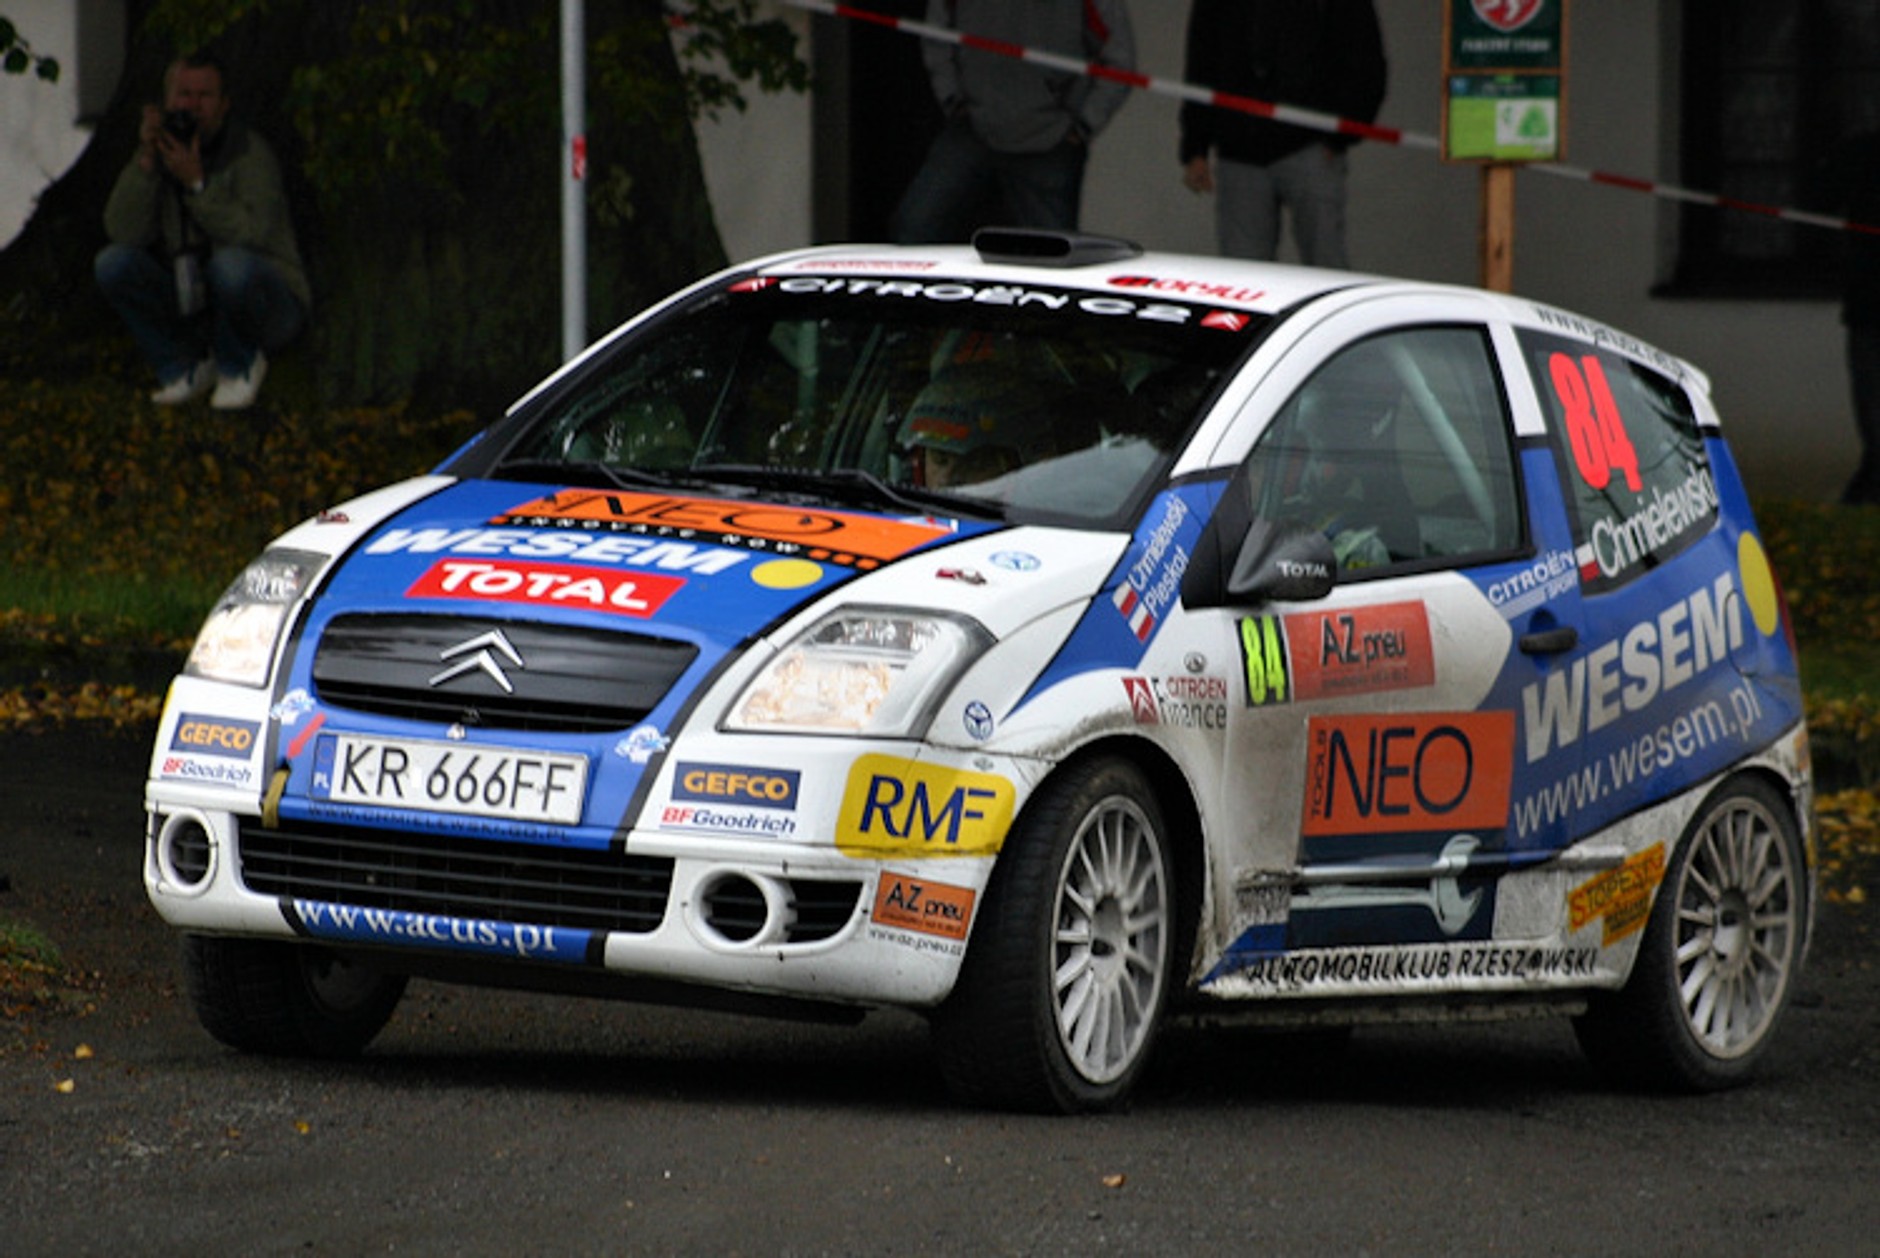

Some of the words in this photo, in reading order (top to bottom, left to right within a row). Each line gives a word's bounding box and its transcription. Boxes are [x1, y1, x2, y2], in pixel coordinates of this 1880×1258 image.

[1078, 297, 1192, 324] C2
[1549, 352, 1643, 492] 84
[365, 528, 750, 576] WESEM
[1488, 549, 1576, 607] CITROËN
[441, 563, 649, 610] TOTAL
[1241, 614, 1286, 705] 84
[1321, 614, 1361, 667] AZ
[1522, 571, 1744, 765] WESEM
[179, 722, 252, 750] GEFCO
[1514, 677, 1763, 839] www.wesem.pl
[313, 773, 329, 788] PL
[341, 744, 410, 798] KR
[425, 752, 575, 812] 666FF
[683, 771, 789, 801] GEFCO
[1324, 726, 1473, 819] NEO
[661, 806, 796, 834] BFGoodrich
[859, 774, 997, 843] RMF
[885, 882, 922, 913] AZ
[294, 898, 558, 957] www.acus.pl
[1249, 949, 1452, 984] AUTOMOBILKLUB
